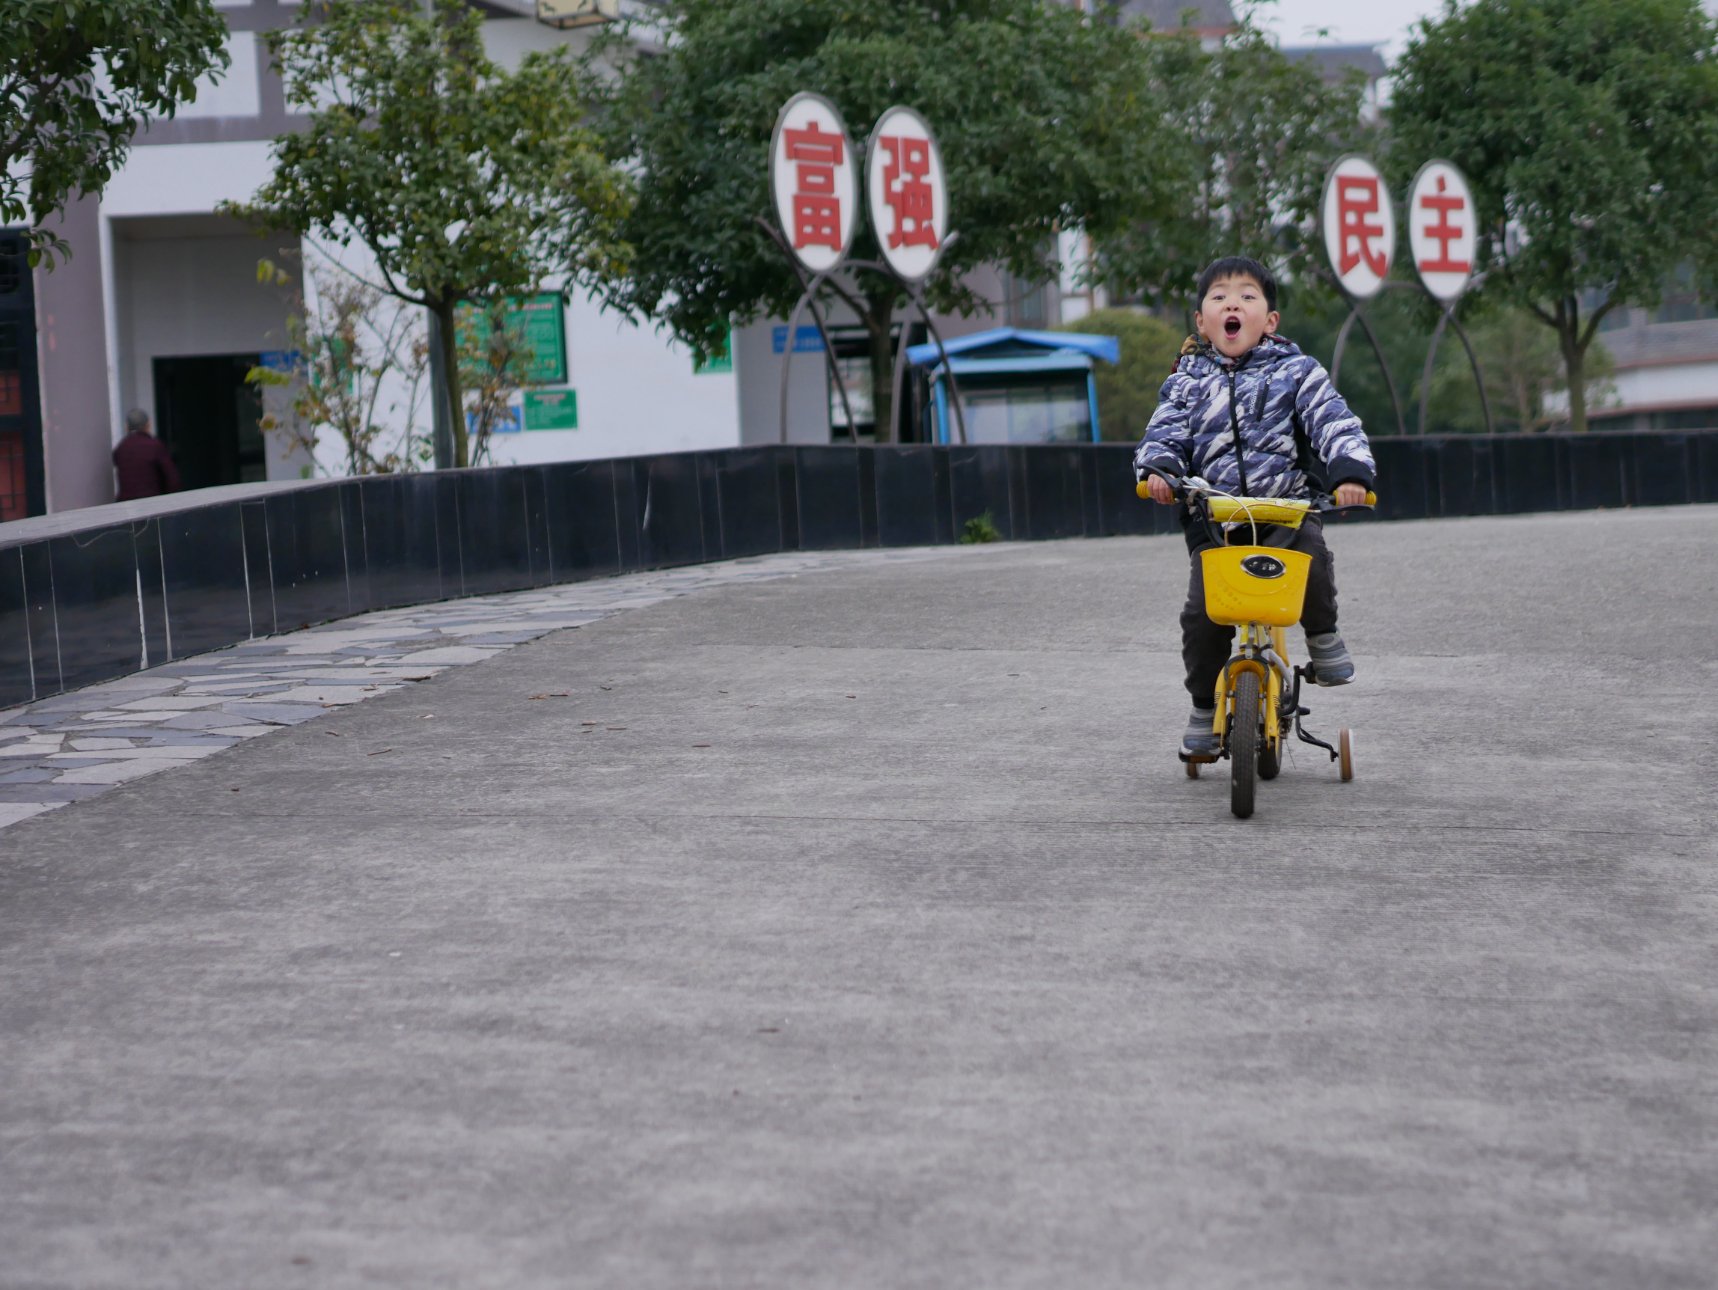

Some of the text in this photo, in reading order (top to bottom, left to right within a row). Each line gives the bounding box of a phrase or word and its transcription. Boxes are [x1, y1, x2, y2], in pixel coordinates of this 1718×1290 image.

[784, 121, 844, 251] 富
[880, 136, 939, 249] 强
[1338, 176, 1387, 278] 民
[1419, 176, 1471, 272] 主
